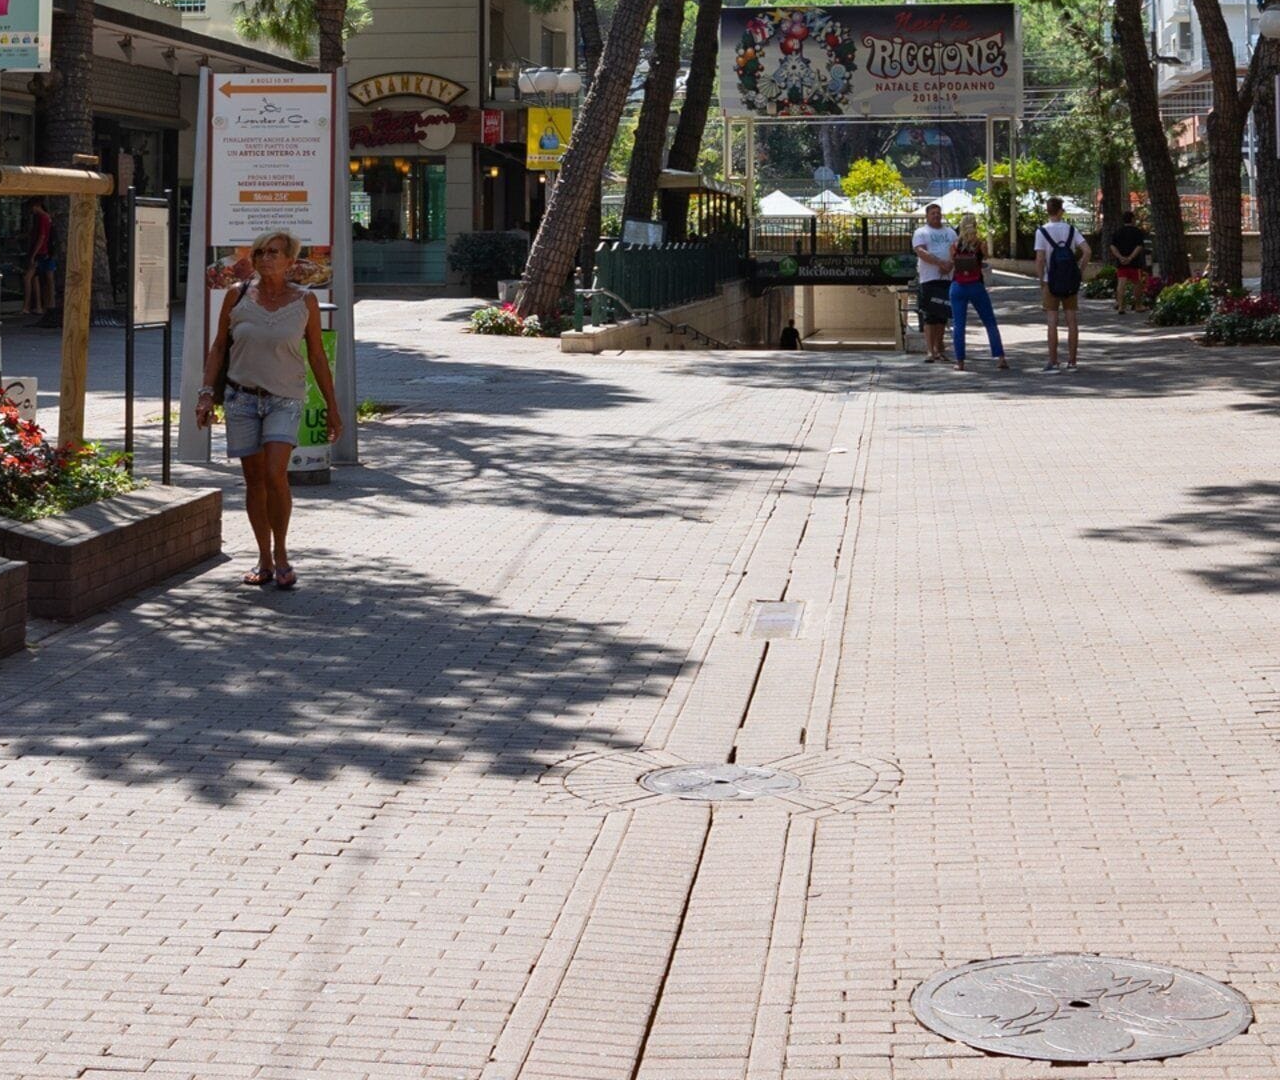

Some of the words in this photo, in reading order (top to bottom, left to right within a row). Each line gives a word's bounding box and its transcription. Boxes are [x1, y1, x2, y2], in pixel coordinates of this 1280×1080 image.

[363, 74, 449, 99] FRANKLY
[875, 82, 919, 92] NATALE
[924, 81, 995, 91] CAPODANNO
[912, 93, 958, 102] 2018-19
